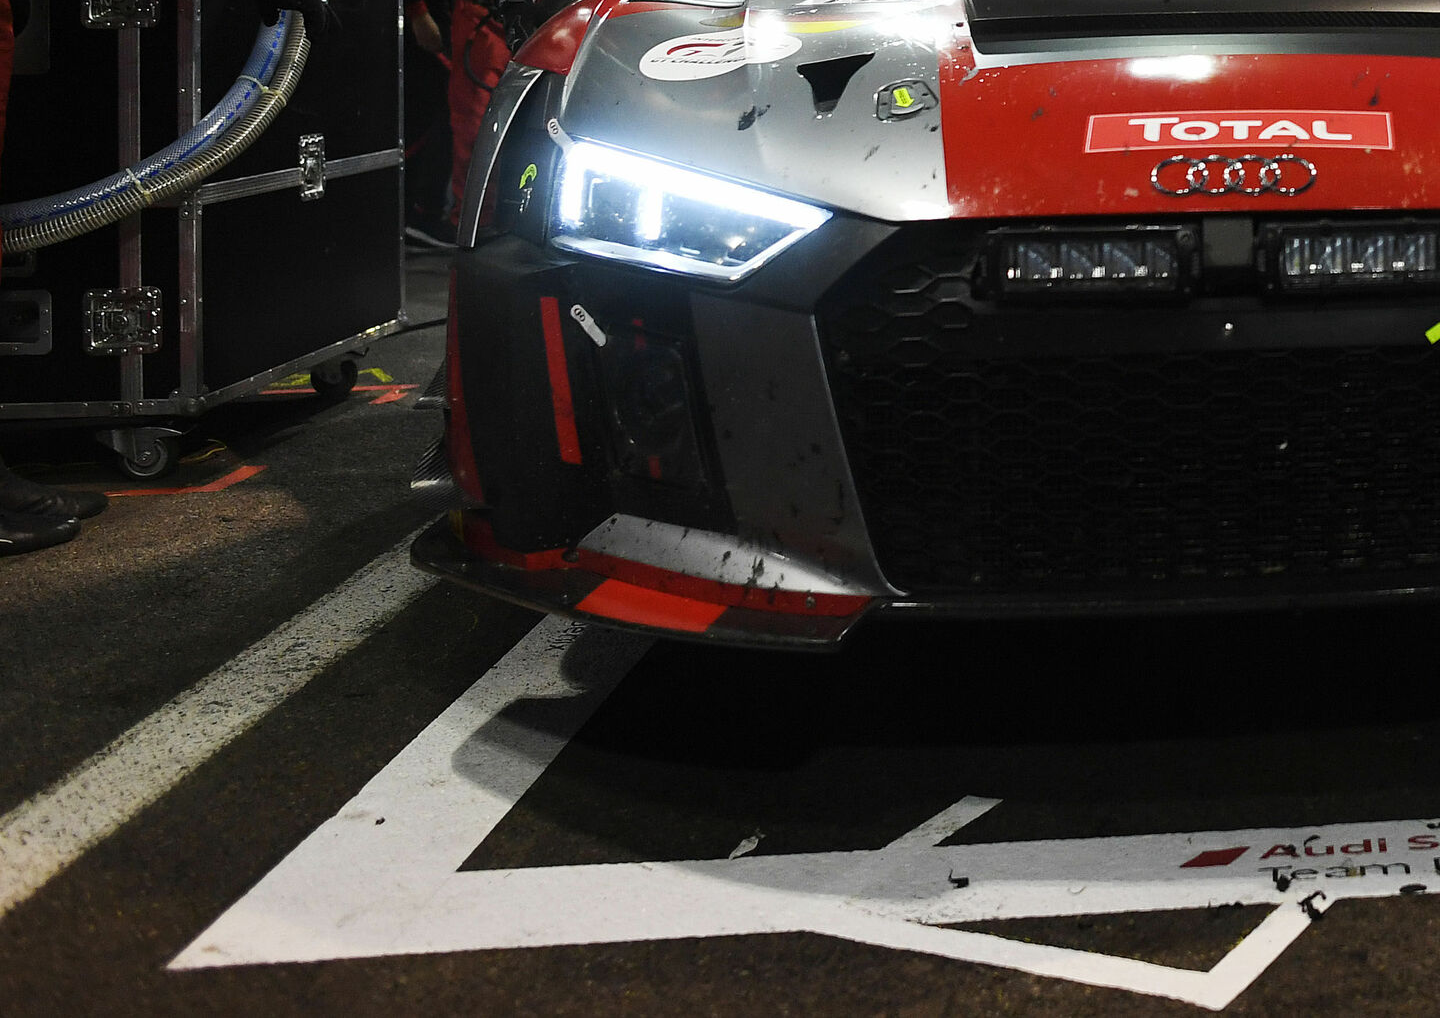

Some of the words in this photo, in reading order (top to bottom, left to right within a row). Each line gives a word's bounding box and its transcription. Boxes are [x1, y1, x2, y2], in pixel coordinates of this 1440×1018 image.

[1127, 116, 1353, 142] TOTAL
[1259, 837, 1387, 860] Audi
[1257, 862, 1411, 882] Team
